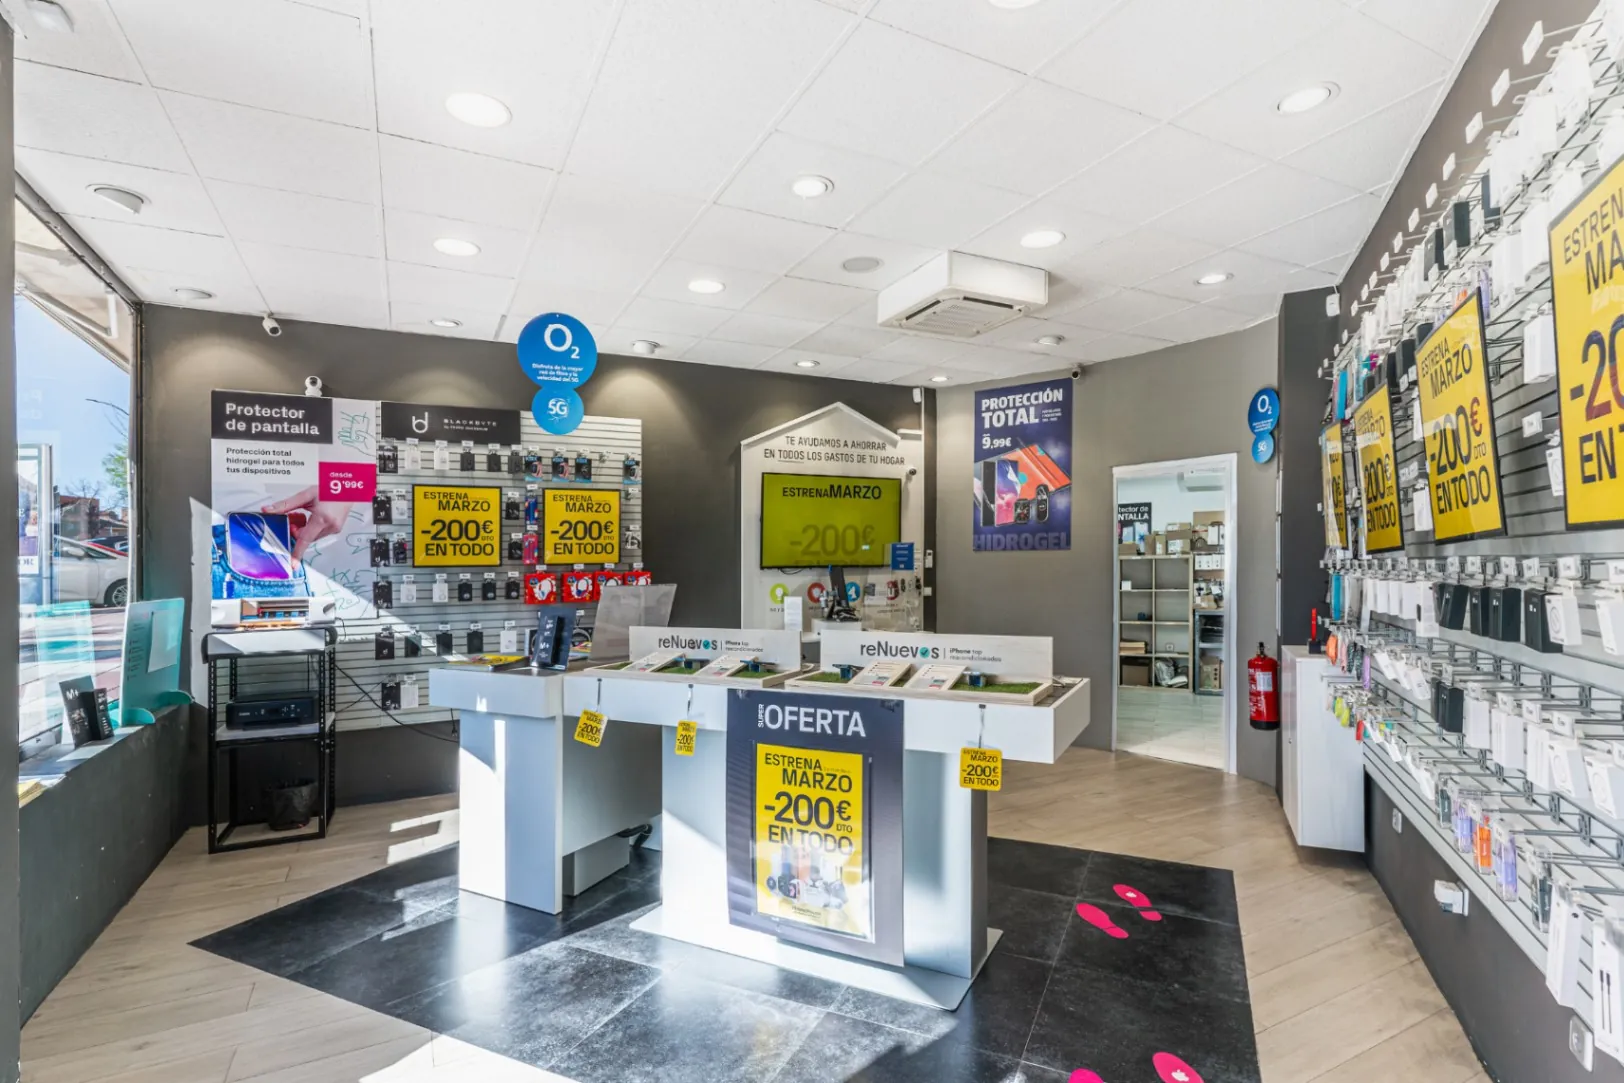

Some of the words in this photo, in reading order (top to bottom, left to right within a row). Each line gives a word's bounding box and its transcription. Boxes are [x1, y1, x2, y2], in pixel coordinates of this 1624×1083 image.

[1421, 338, 1450, 378] ESTRENA
[1430, 344, 1472, 399] MARZO
[548, 400, 568, 415] 5G
[982, 388, 1063, 411] PROTECCIÓN
[226, 403, 305, 419] Protector
[982, 407, 1039, 429] TOTAL
[226, 419, 246, 431] de
[252, 422, 320, 435] pantalla
[444, 419, 497, 427] BLACKBYTE
[786, 436, 795, 445] TE
[798, 437, 841, 448] AYUDAMOS
[843, 440, 849, 448] A
[851, 440, 886, 450] AHORRAR
[1430, 396, 1482, 476] -200€
[226, 448, 271, 456] Protección
[764, 449, 775, 458] EN
[778, 450, 804, 460] TODOS
[807, 452, 822, 461] LOS
[824, 452, 854, 463] GASTOS
[857, 455, 866, 463] DE
[869, 455, 878, 463] TU
[880, 456, 905, 465] HOGAR
[1474, 442, 1486, 460] DTO
[1578, 426, 1616, 484] EN
[226, 457, 260, 466] hidrogel
[242, 468, 291, 476] dispositivos
[424, 492, 469, 500] ESTRENA
[1436, 480, 1452, 514] EN
[1451, 465, 1490, 510] TODO
[438, 500, 490, 512] MARZO
[565, 502, 611, 513] MARZO
[421, 519, 493, 541] -200€
[550, 520, 614, 540] -200€
[554, 543, 574, 555] EN
[577, 543, 614, 555] TODO
[790, 524, 875, 556] -200€
[974, 532, 1069, 550] HIDROGEL
[425, 544, 448, 556] EN
[451, 544, 494, 556] TODO
[764, 704, 866, 737] OFERTA
[765, 753, 822, 771] ESTRENA
[782, 768, 852, 793] MARZO
[976, 778, 999, 786] TODO
[764, 791, 852, 830] -200€
[836, 824, 852, 833] DTO
[769, 824, 793, 845] EN
[797, 829, 854, 855] TODO
